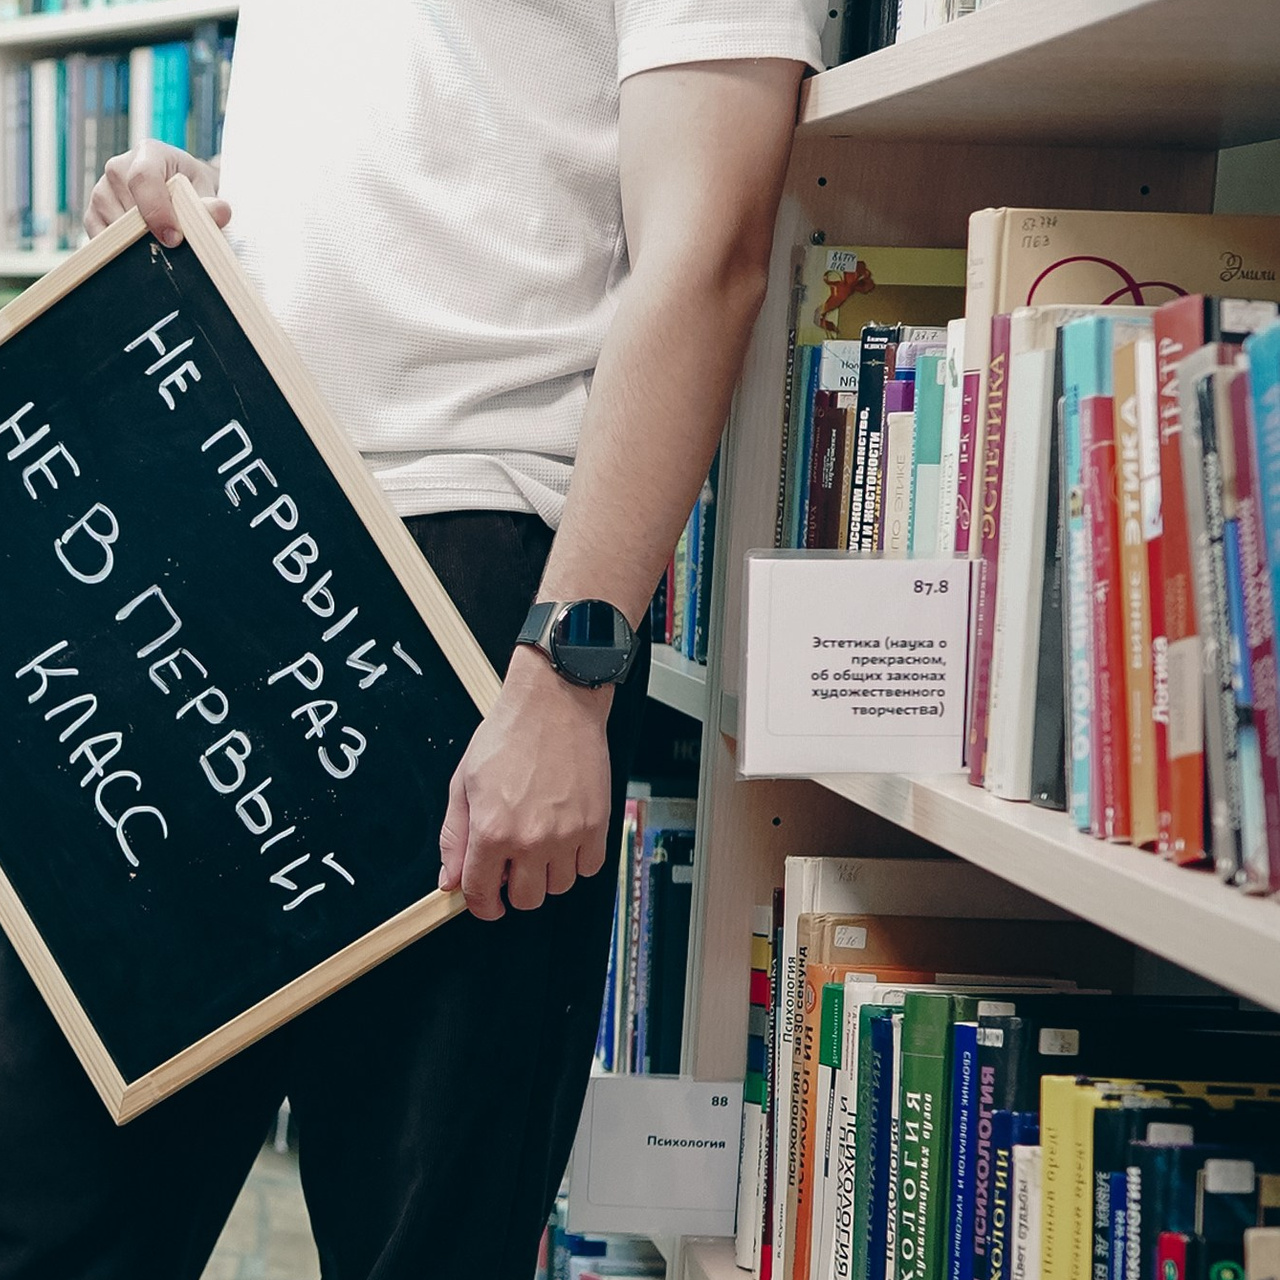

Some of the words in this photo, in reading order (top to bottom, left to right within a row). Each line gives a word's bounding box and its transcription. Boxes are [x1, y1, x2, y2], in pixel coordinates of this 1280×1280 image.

[1219, 250, 1277, 282] Эмили
[1157, 336, 1184, 445] ТЕАТР
[862, 429, 880, 522] ЖЕСТОКОСТИ
[981, 351, 1006, 540] ЭСТЕТИКА
[1121, 393, 1142, 547] ЭТИКА
[124, 308, 202, 410] НЕ
[201, 418, 423, 691] ПЕРВЫЙ
[894, 454, 907, 512] ЭТИКЕ
[862, 525, 873, 534] И
[913, 580, 949, 595] 87.8
[812, 636, 880, 649] Эстетика
[884, 636, 934, 651] (наука
[938, 640, 947, 649] о
[851, 656, 947, 667] прекрасном,
[54, 501, 120, 585] В
[115, 583, 356, 913] ПЕРВЫЙ
[811, 670, 829, 681] об
[833, 670, 882, 683] общих
[886, 672, 946, 681] законах
[811, 688, 946, 700] художественного
[1151, 635, 1170, 724] Логика
[268, 651, 368, 780] РАЗ
[851, 702, 945, 718] творчества)
[14, 639, 168, 868] КЛАСС
[782, 956, 797, 1043] Психология
[795, 945, 809, 1008] секунд
[794, 1012, 804, 1034] 30
[794, 1036, 803, 1055] за
[710, 1096, 729, 1108] 88
[840, 1095, 848, 1112] И
[961, 1051, 972, 1105] СБОРНИК
[646, 1135, 727, 1151] Психология
[788, 1070, 801, 1186] ПСИХОЛОГИЯ
[958, 1109, 968, 1177] РЕФЕРАТОВ
[885, 1117, 899, 1261] ПСИХОЛОГИЯ
[914, 1145, 931, 1278] гуманитарных
[923, 1092, 932, 1140] вузов
[973, 1066, 996, 1256] ПСИХОЛОГИЯ
[838, 1110, 857, 1277] ПСИХОЛОГИЯ
[954, 1193, 964, 1252] КУРСОВЫХ
